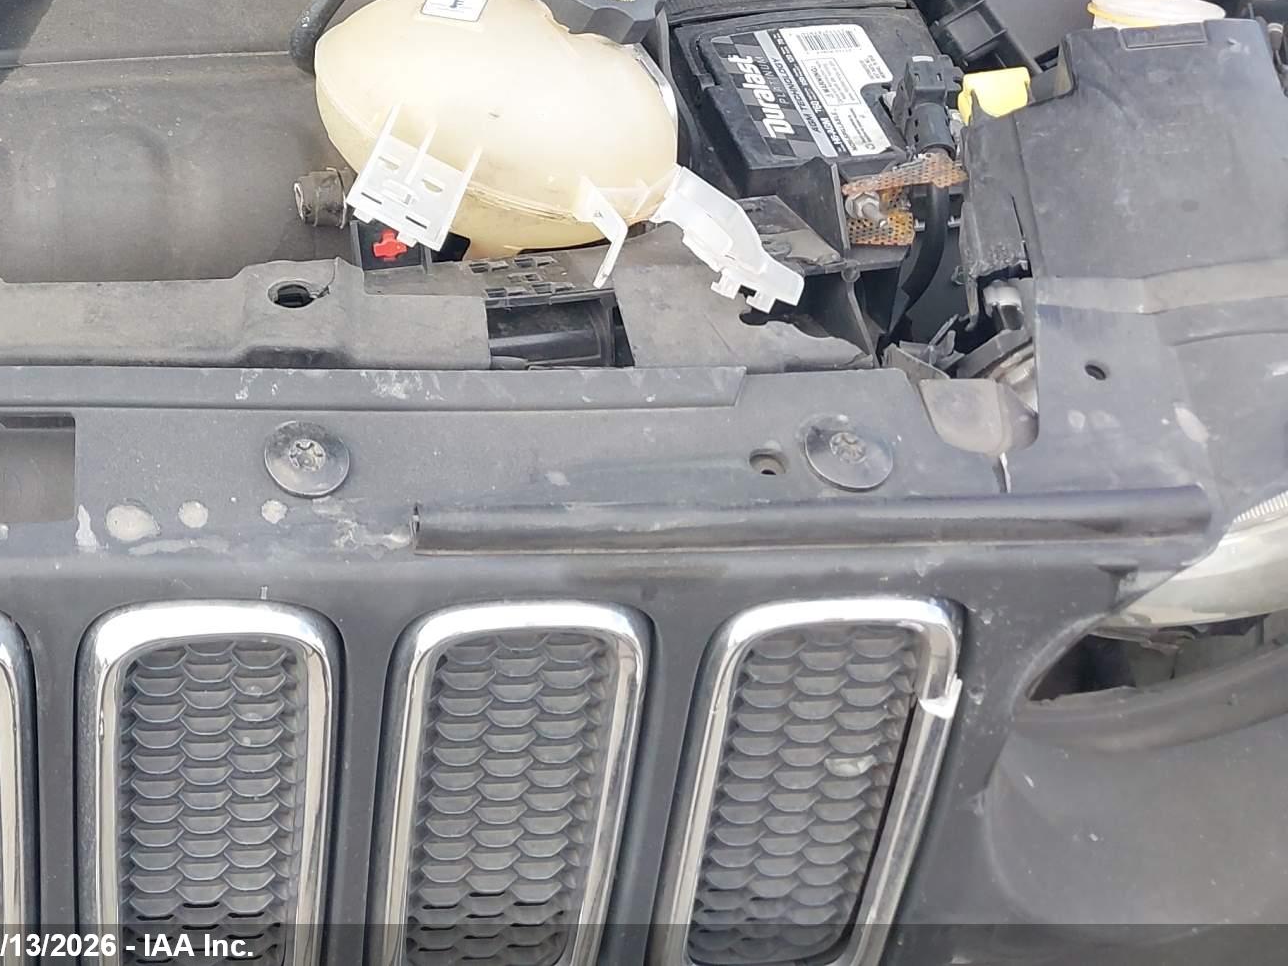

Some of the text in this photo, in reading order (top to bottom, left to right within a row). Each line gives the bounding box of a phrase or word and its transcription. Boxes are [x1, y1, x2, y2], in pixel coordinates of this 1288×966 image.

[727, 55, 794, 138] Duralast
[755, 56, 789, 104] PLATINUM
[771, 57, 807, 110] TECHNOLOGY
[804, 113, 820, 132] AGM
